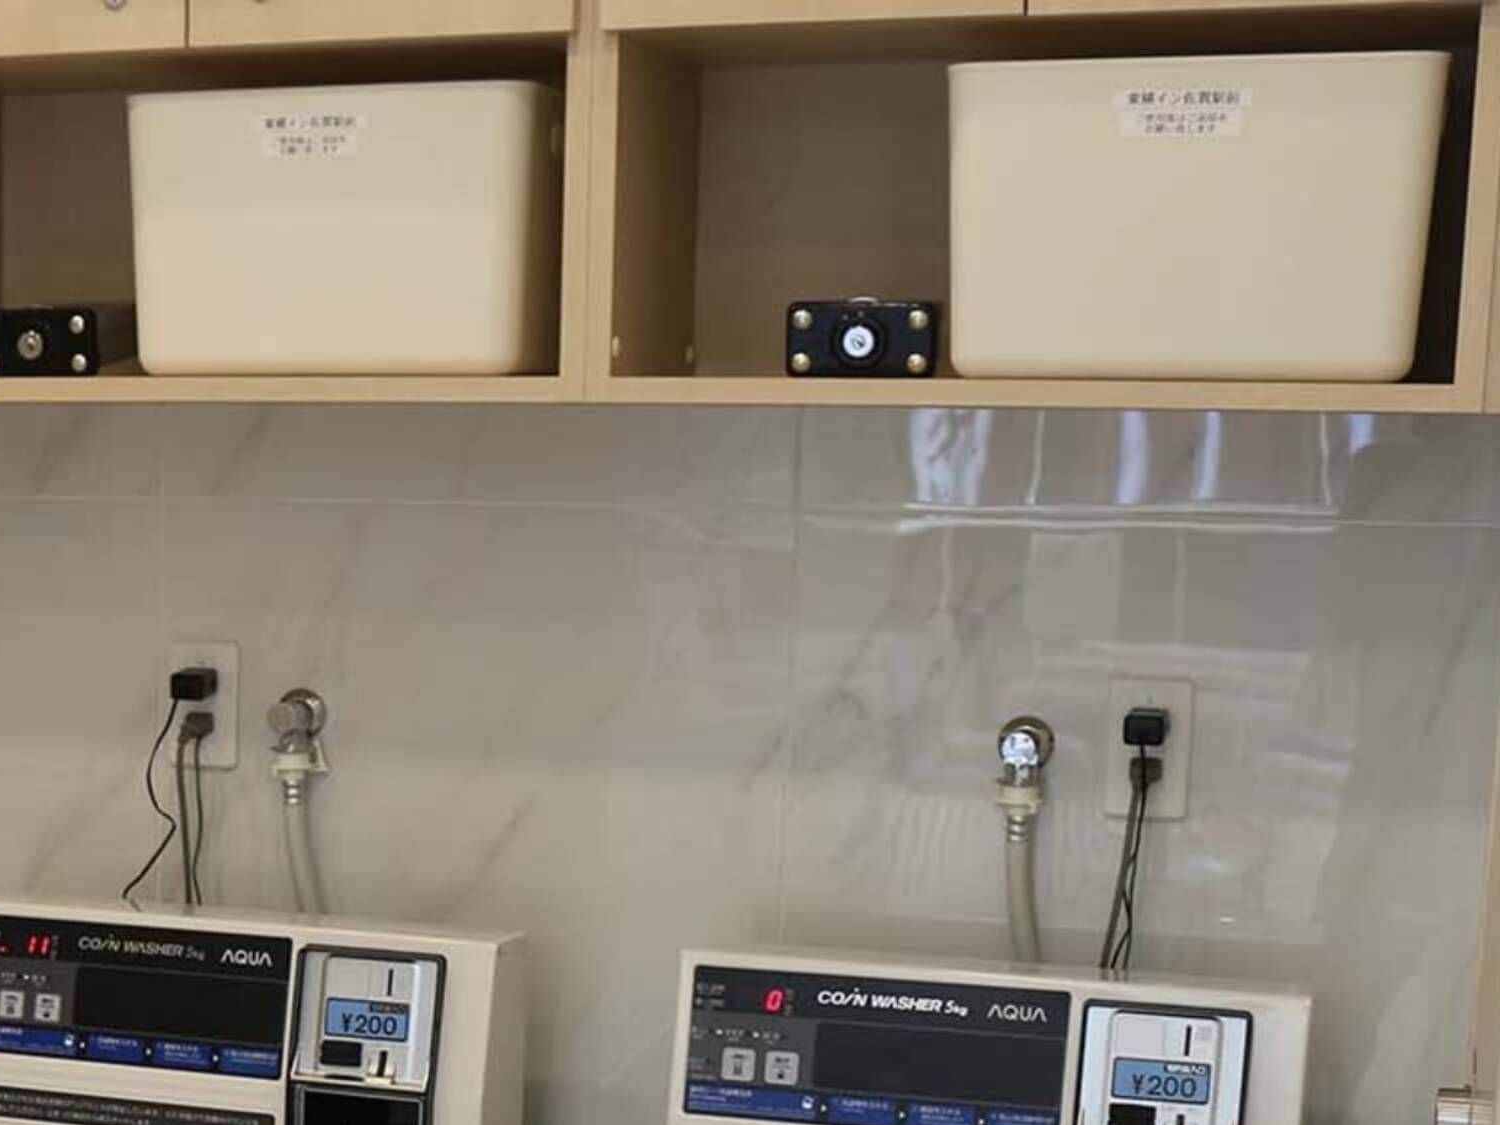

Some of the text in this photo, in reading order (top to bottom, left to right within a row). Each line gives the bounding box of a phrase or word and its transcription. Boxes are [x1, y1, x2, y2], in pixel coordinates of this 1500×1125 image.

[121, 940, 185, 959] WASHER
[221, 949, 273, 967] AQUA
[764, 988, 784, 1012] 0
[870, 994, 943, 1013] WASHER
[944, 1000, 969, 1017] 5kg
[342, 1013, 398, 1035] ¥200
[987, 1004, 1048, 1023] AQUA
[1131, 1072, 1197, 1098] ¥200
